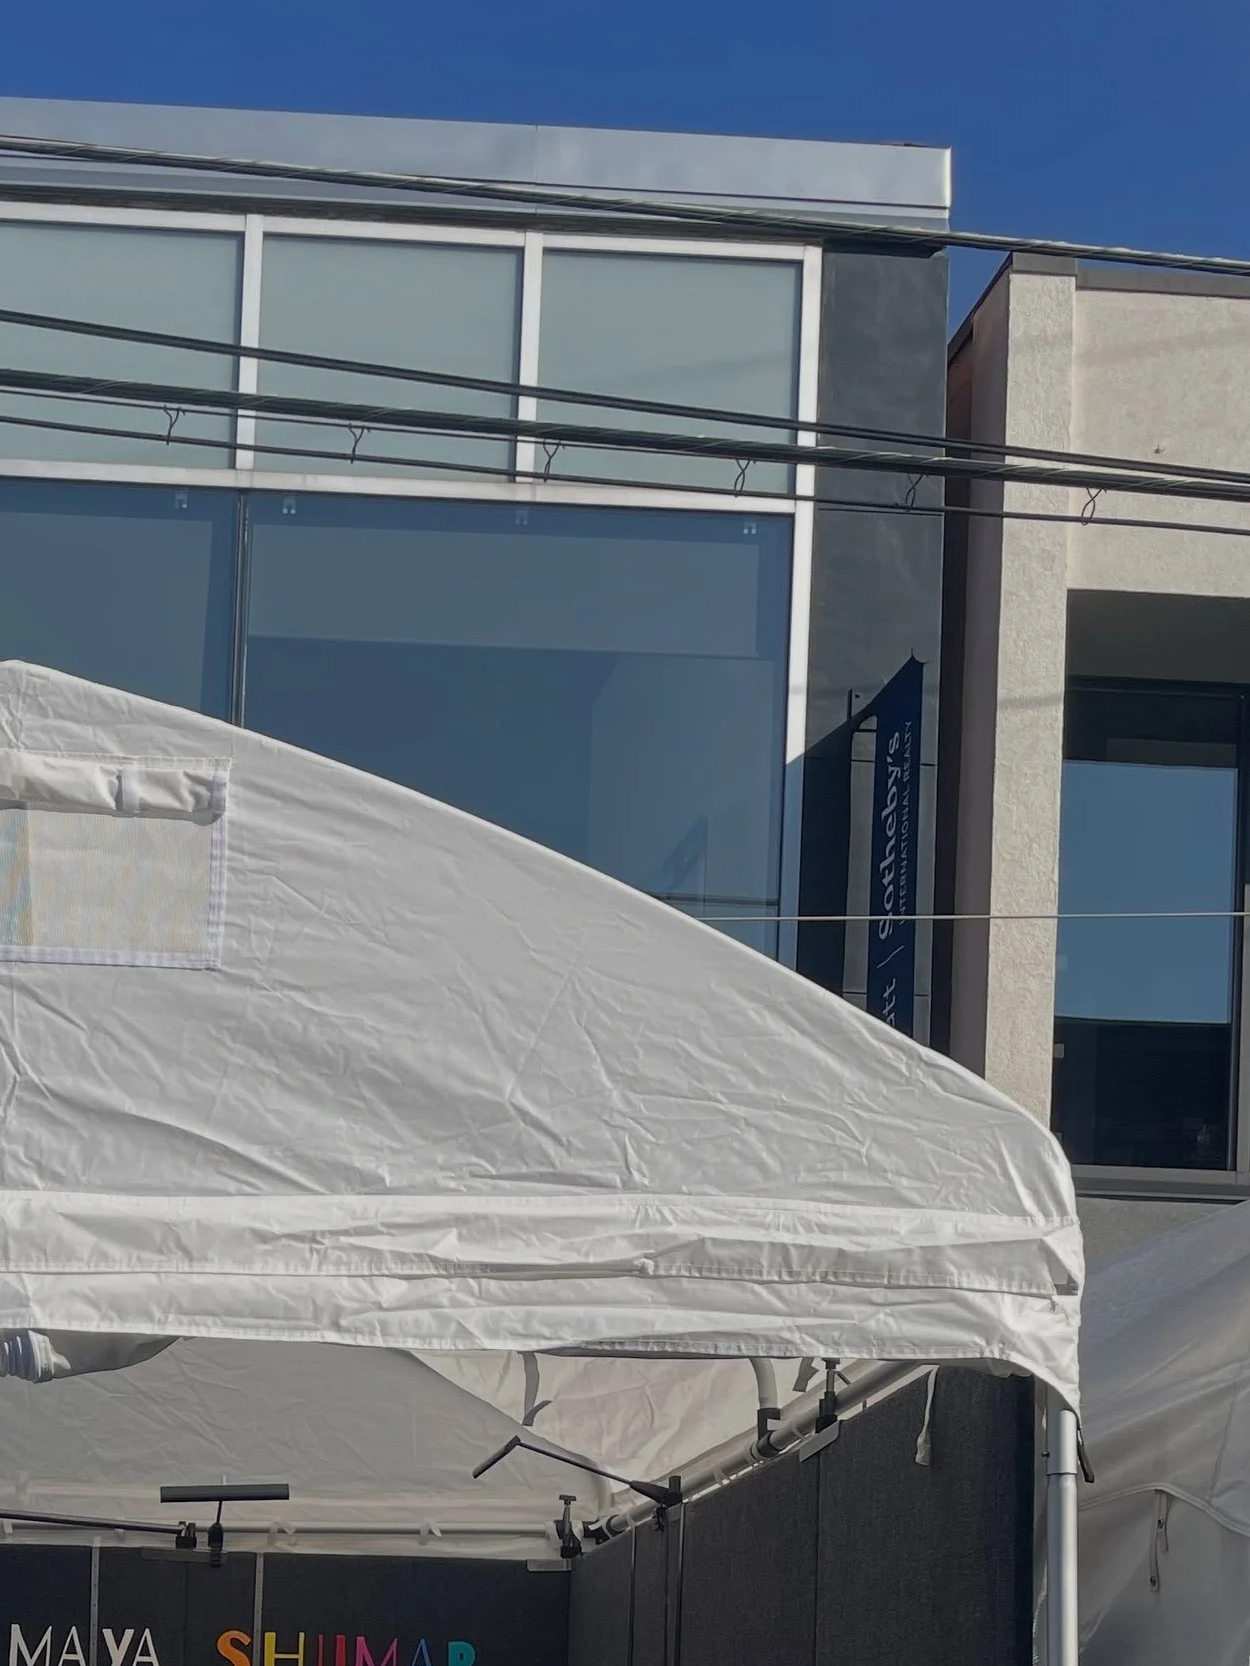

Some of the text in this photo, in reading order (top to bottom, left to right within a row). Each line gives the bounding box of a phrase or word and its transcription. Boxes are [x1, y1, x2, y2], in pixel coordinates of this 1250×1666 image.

[902, 720, 913, 781] REALTY
[878, 731, 901, 1028] att Sotheby's
